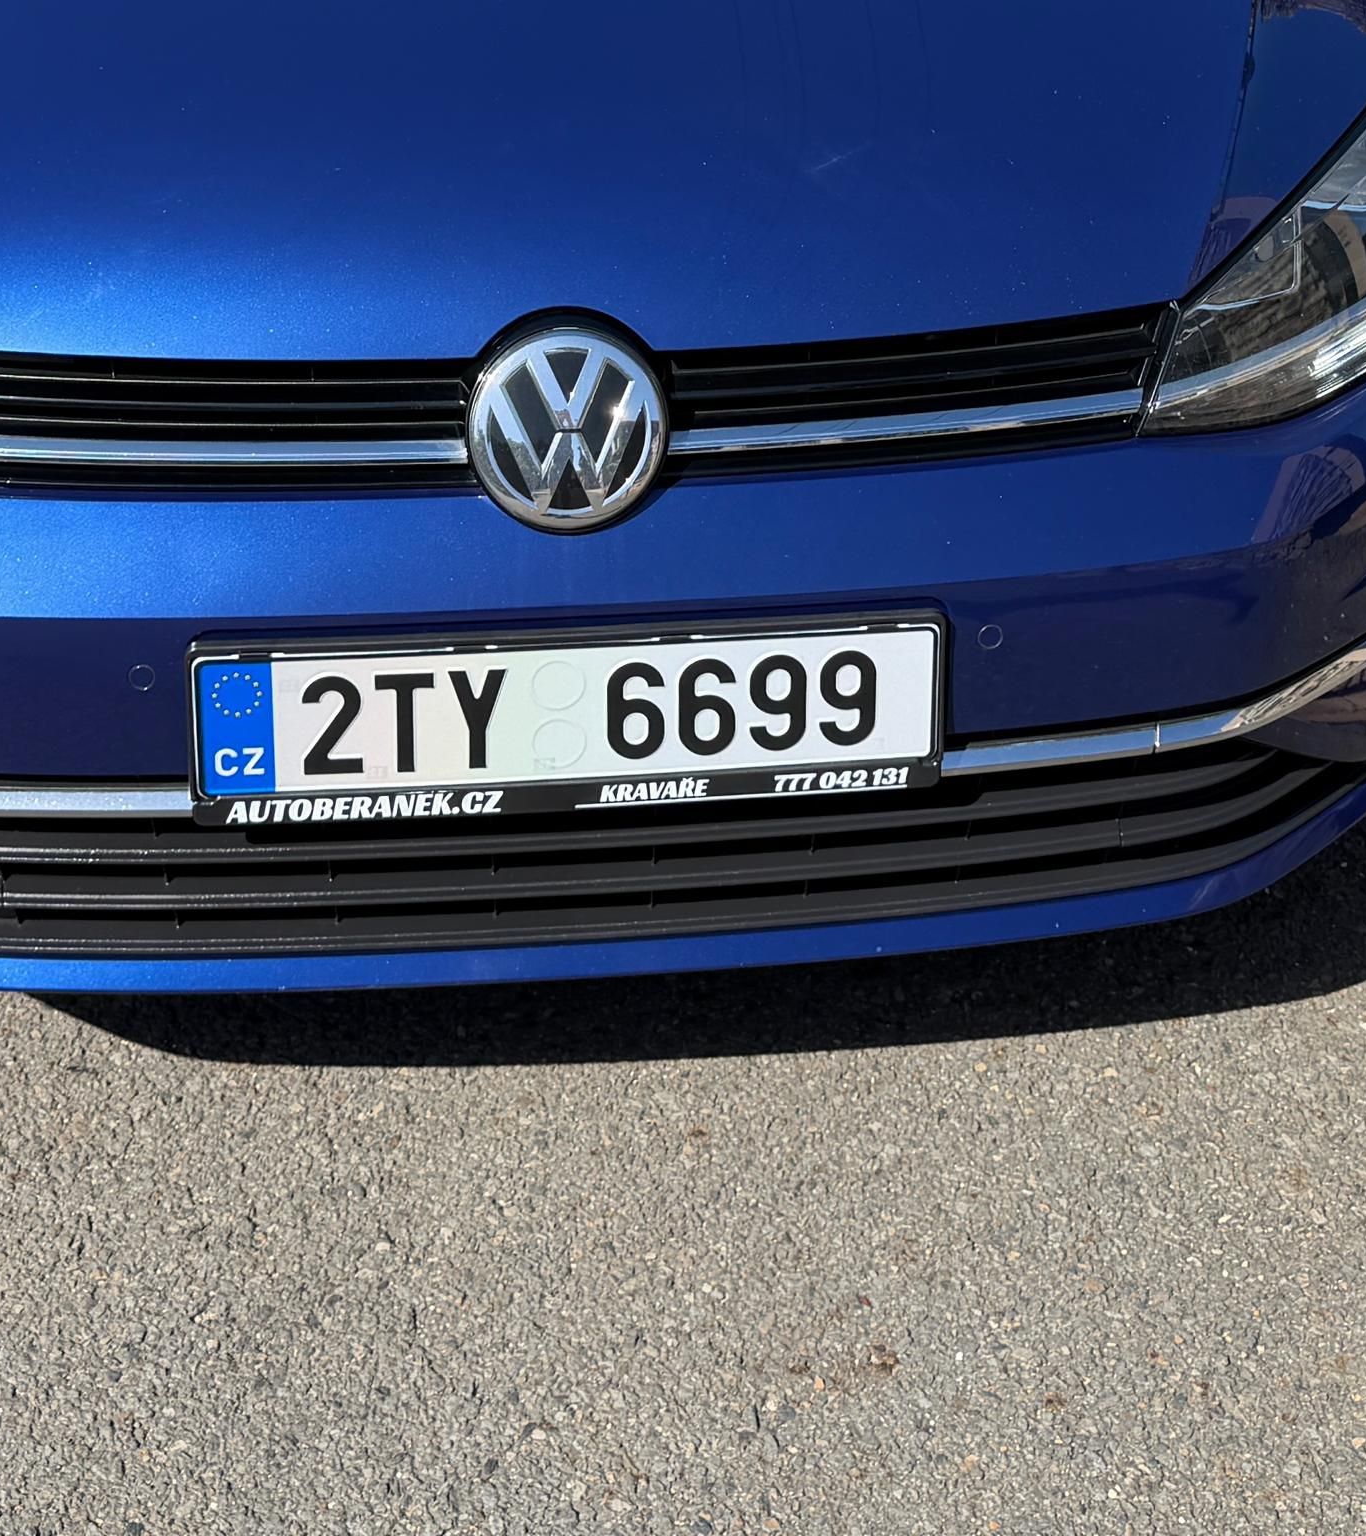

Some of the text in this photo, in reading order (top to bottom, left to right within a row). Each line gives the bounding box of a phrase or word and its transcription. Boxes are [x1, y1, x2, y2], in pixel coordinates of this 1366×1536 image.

[302, 650, 876, 775] 2TY 6699
[214, 747, 265, 776] CZ
[226, 767, 909, 824] AUTOBERANEK.CZ KRAVAŘE 777 042 131
